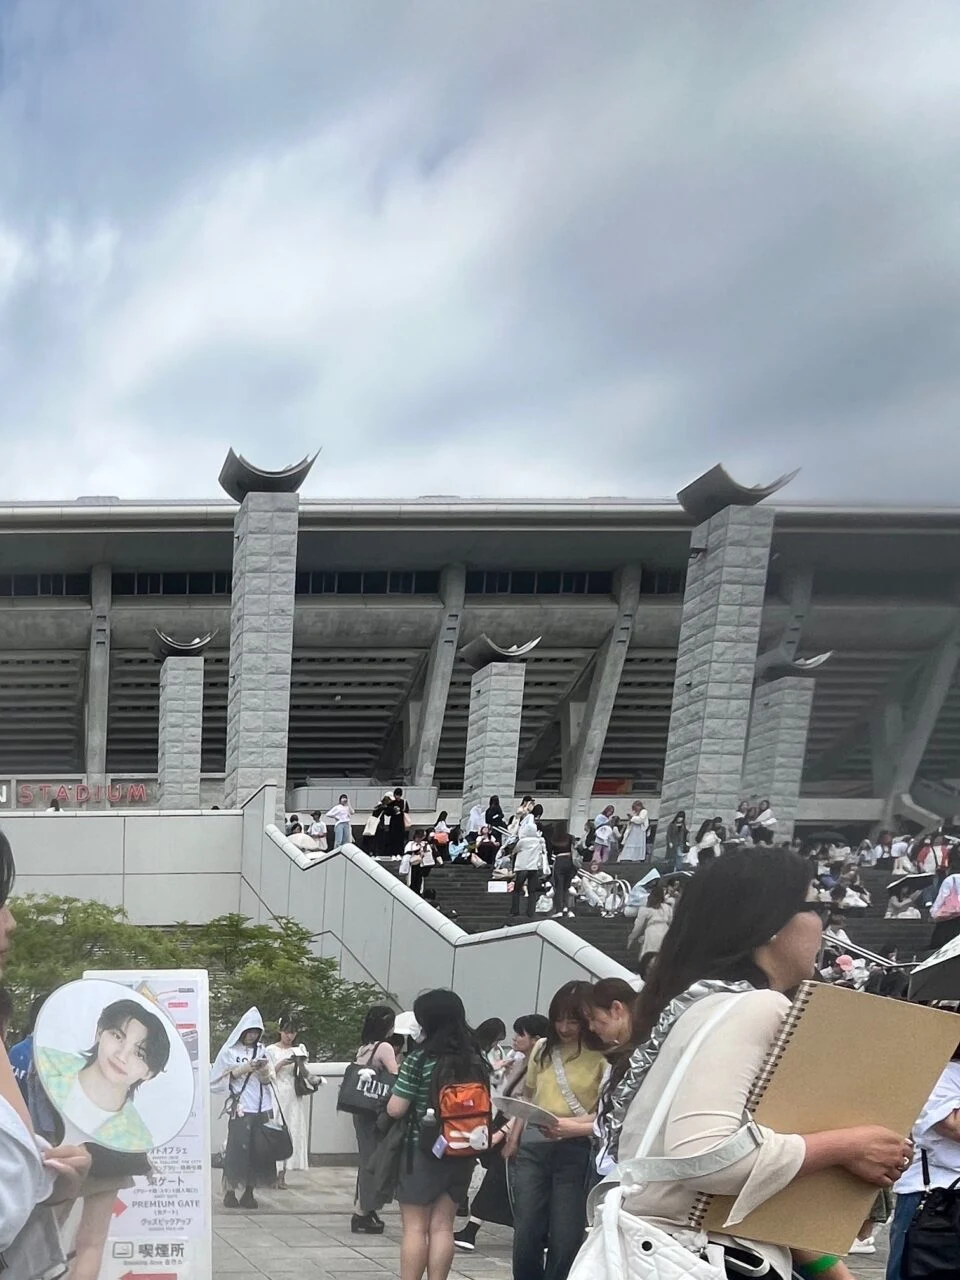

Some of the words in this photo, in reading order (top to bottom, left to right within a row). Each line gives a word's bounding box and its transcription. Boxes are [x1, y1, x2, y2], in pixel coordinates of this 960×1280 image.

[19, 784, 147, 805] STADIUM
[131, 1200, 175, 1208] PREMIUM
[177, 1199, 200, 1208] GATE
[138, 1243, 184, 1258] 喫煙所
